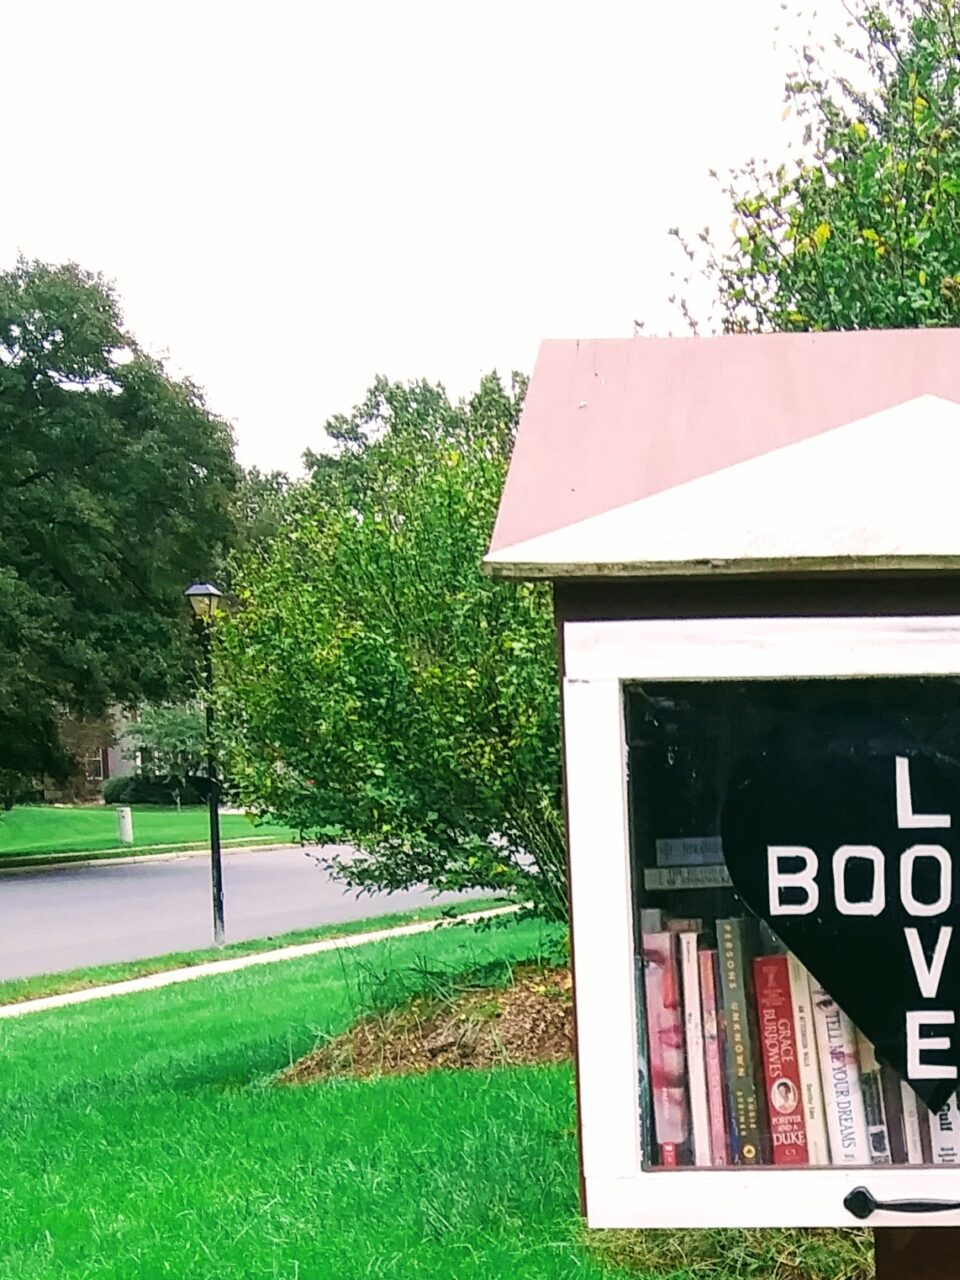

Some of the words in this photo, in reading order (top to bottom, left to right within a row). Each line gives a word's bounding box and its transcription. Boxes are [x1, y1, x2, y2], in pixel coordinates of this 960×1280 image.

[724, 923, 737, 990] PERSONS
[731, 1002, 745, 1078] UNKNOWN
[762, 1008, 783, 1079] BURROWES
[778, 1018, 795, 1064] GRACE
[825, 1011, 841, 1042] TELL
[829, 1043, 846, 1066] ME
[832, 1065, 849, 1099] YOUR
[773, 1130, 806, 1145] DUKE
[777, 1123, 792, 1132] AND
[836, 1099, 857, 1149] DREAMS
